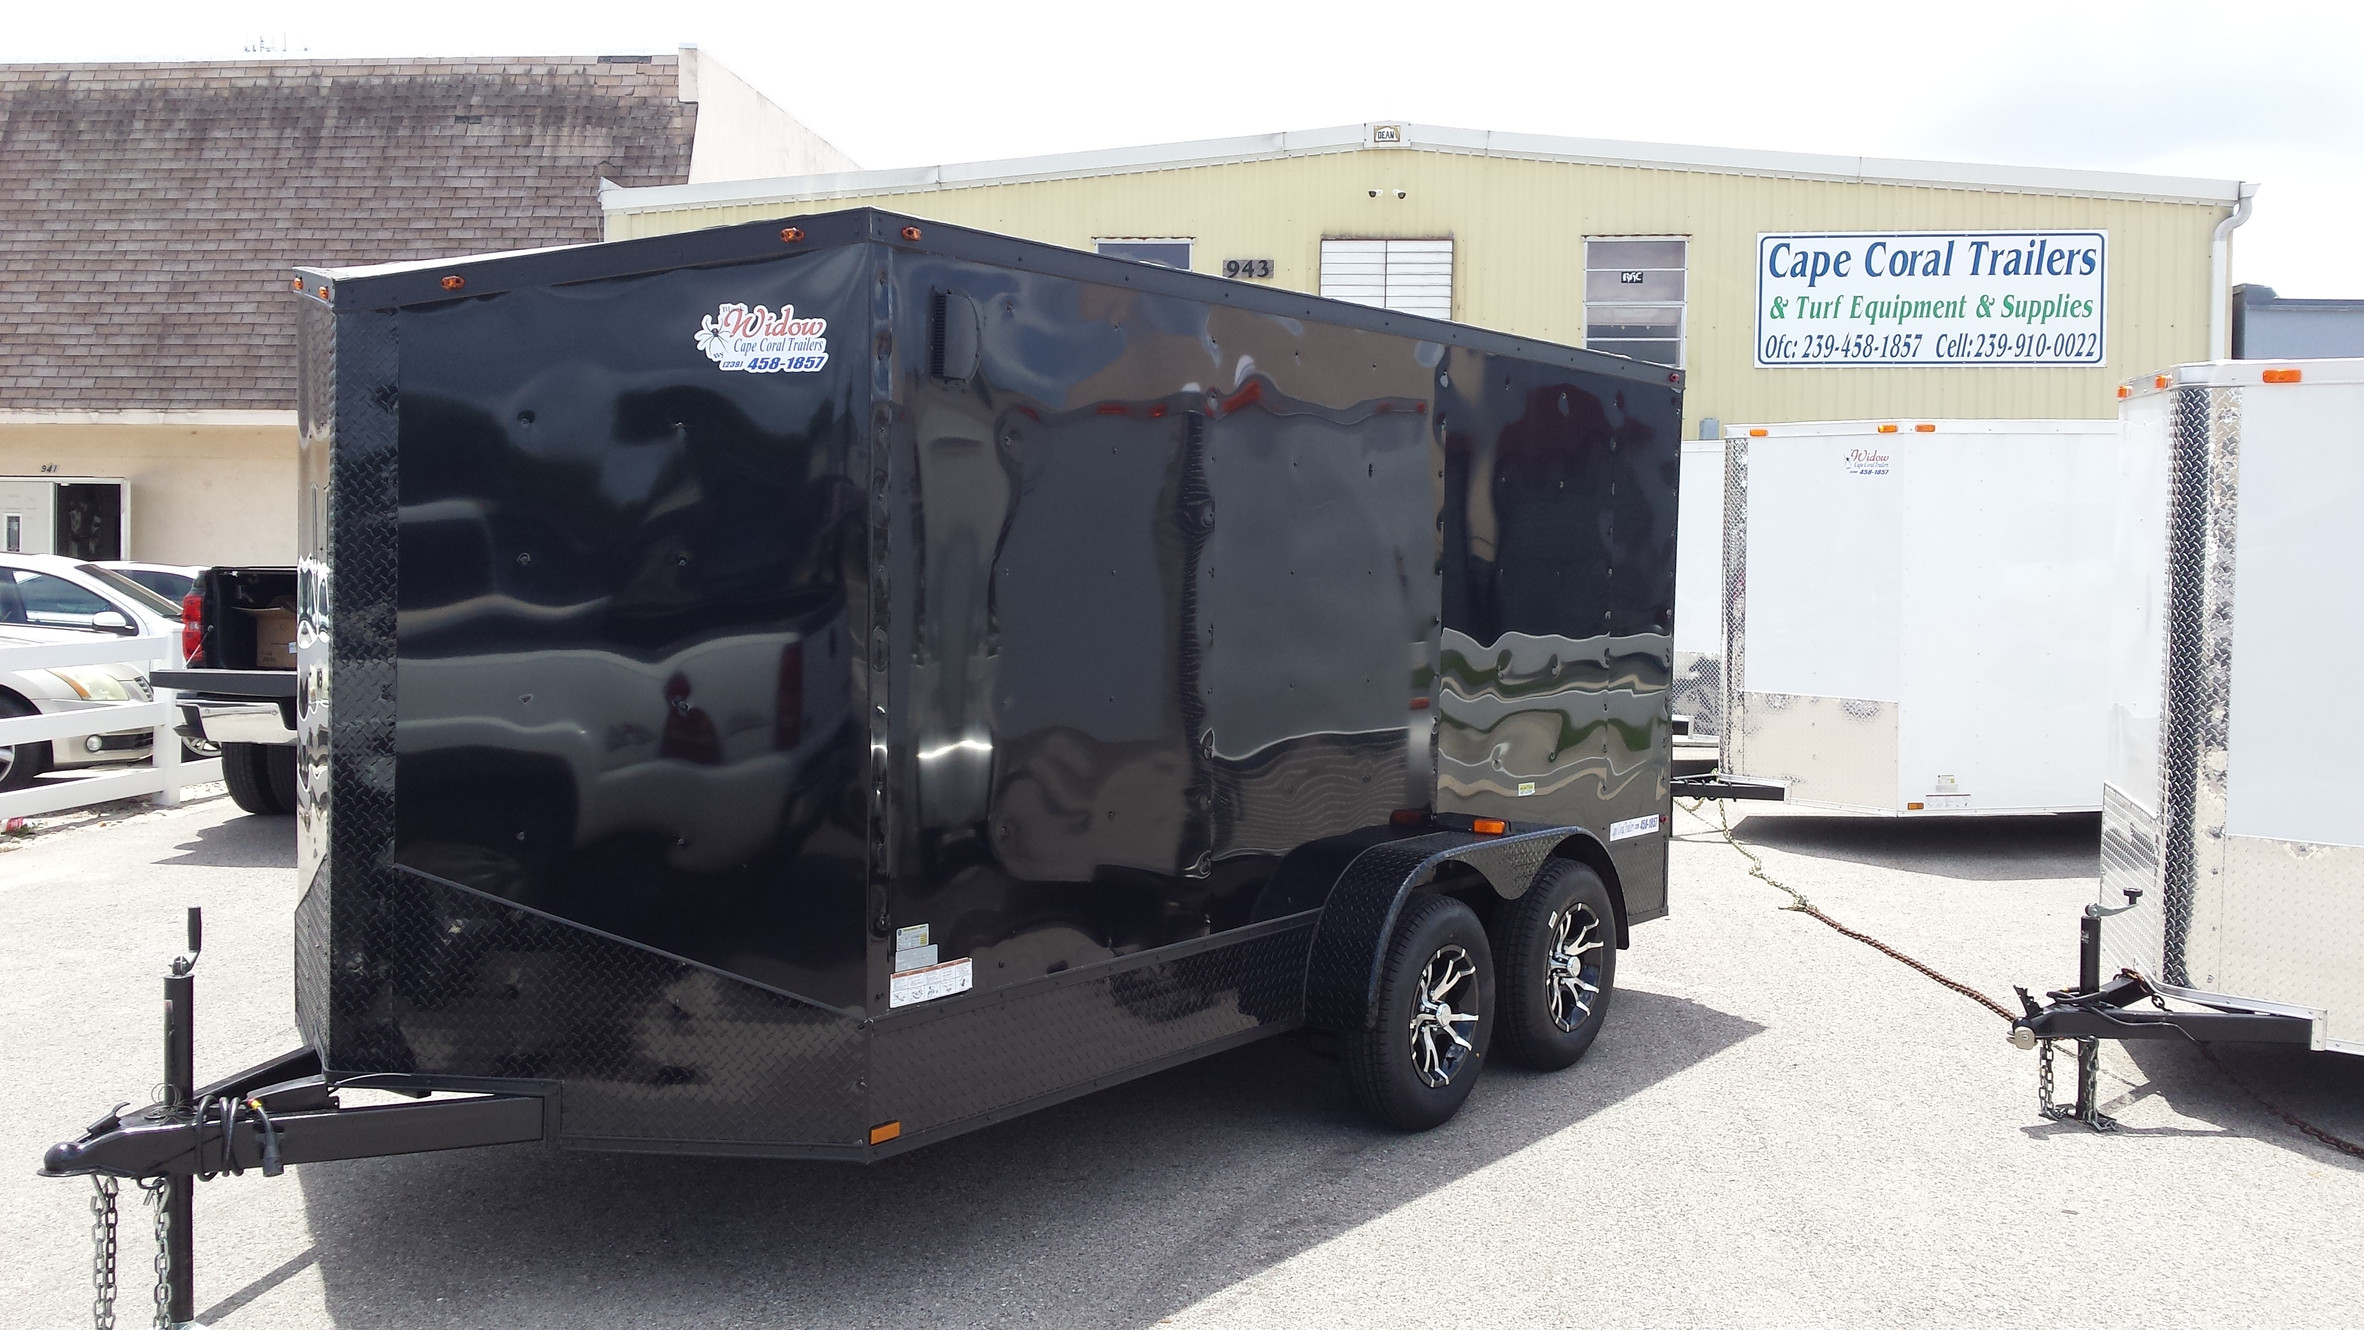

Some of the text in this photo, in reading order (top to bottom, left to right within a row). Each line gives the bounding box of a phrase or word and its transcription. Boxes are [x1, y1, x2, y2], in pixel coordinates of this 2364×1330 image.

[1226, 259, 1270, 279] 943
[1769, 239, 2097, 288] Cape Coral Trailers
[1769, 293, 2094, 326] & Turf Equipment & Supplies
[723, 307, 824, 339] Widow
[733, 337, 824, 356] Cape Coral Trailers
[1765, 333, 1798, 359] Ofc:
[1801, 332, 1923, 359] 239-458-1857
[747, 356, 825, 371] 458-1857
[1850, 449, 1890, 462] Widow
[40, 464, 58, 473] 941
